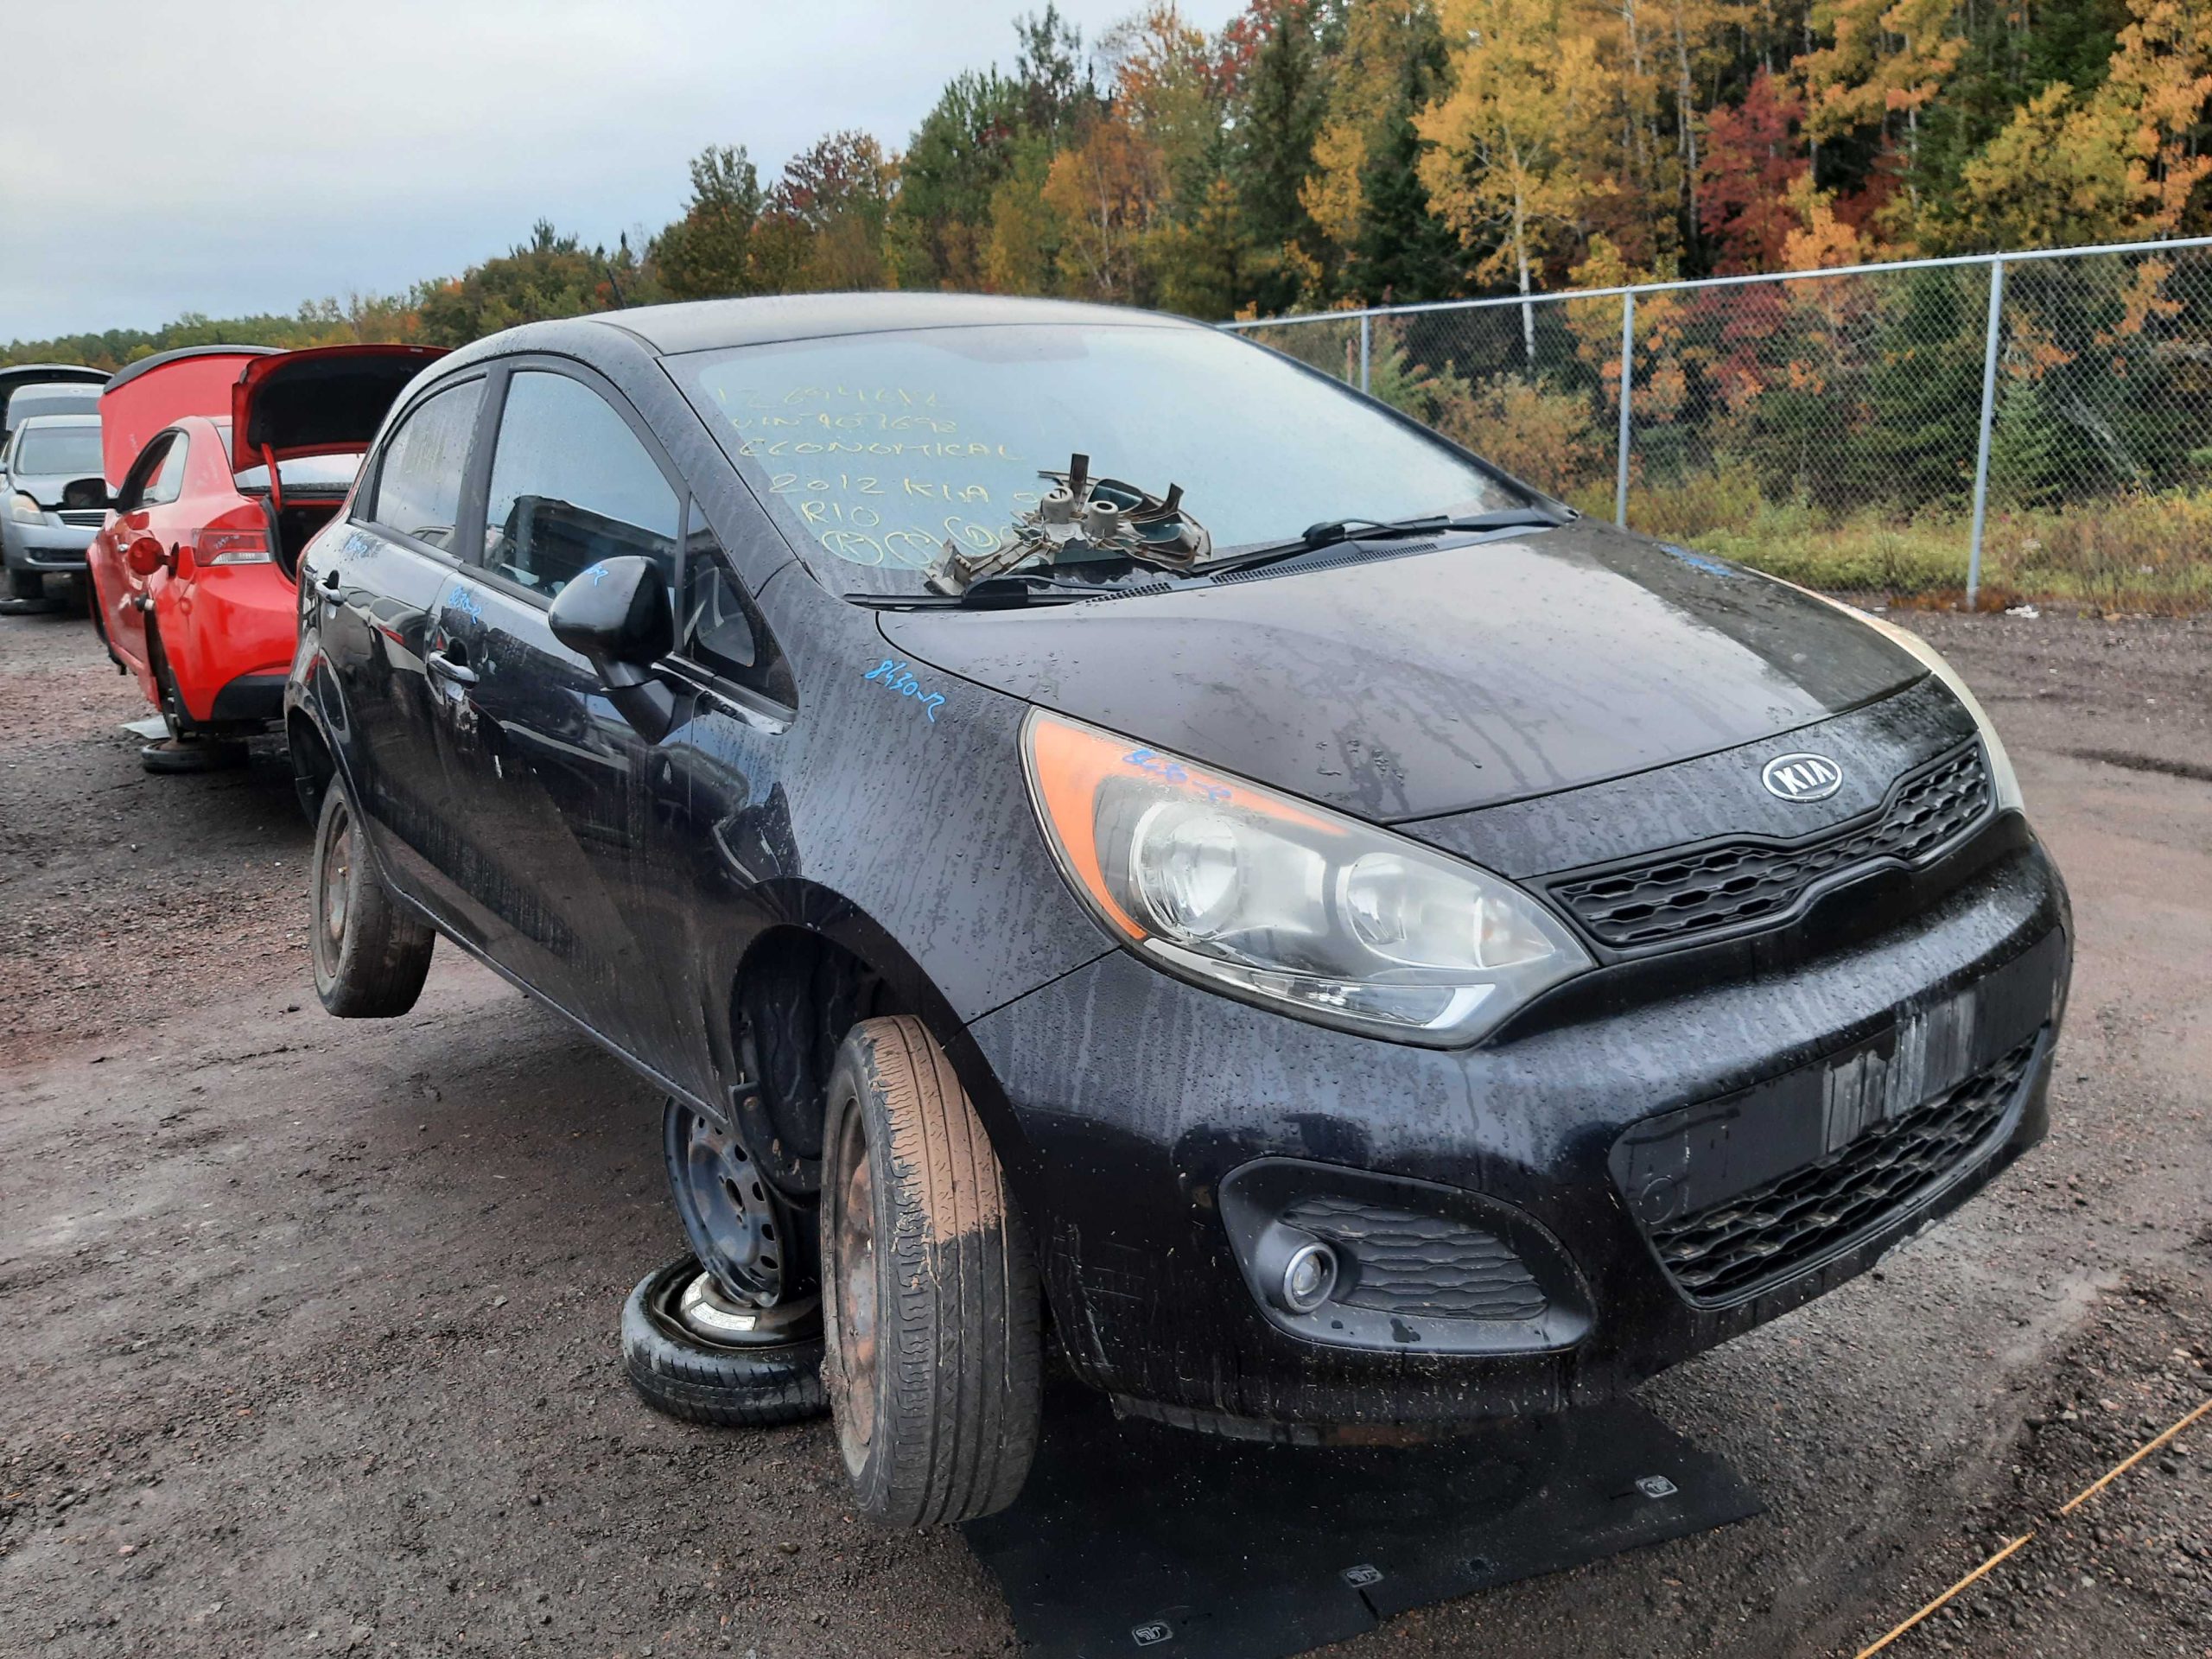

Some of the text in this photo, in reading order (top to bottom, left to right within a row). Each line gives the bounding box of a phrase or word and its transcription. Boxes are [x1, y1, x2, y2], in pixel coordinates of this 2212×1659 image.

[740, 438, 1026, 461] ECONOMICAL
[768, 474, 885, 494] 2012
[904, 478, 990, 504] KIA
[801, 501, 880, 527] RIO
[1773, 760, 1836, 796] KIA
